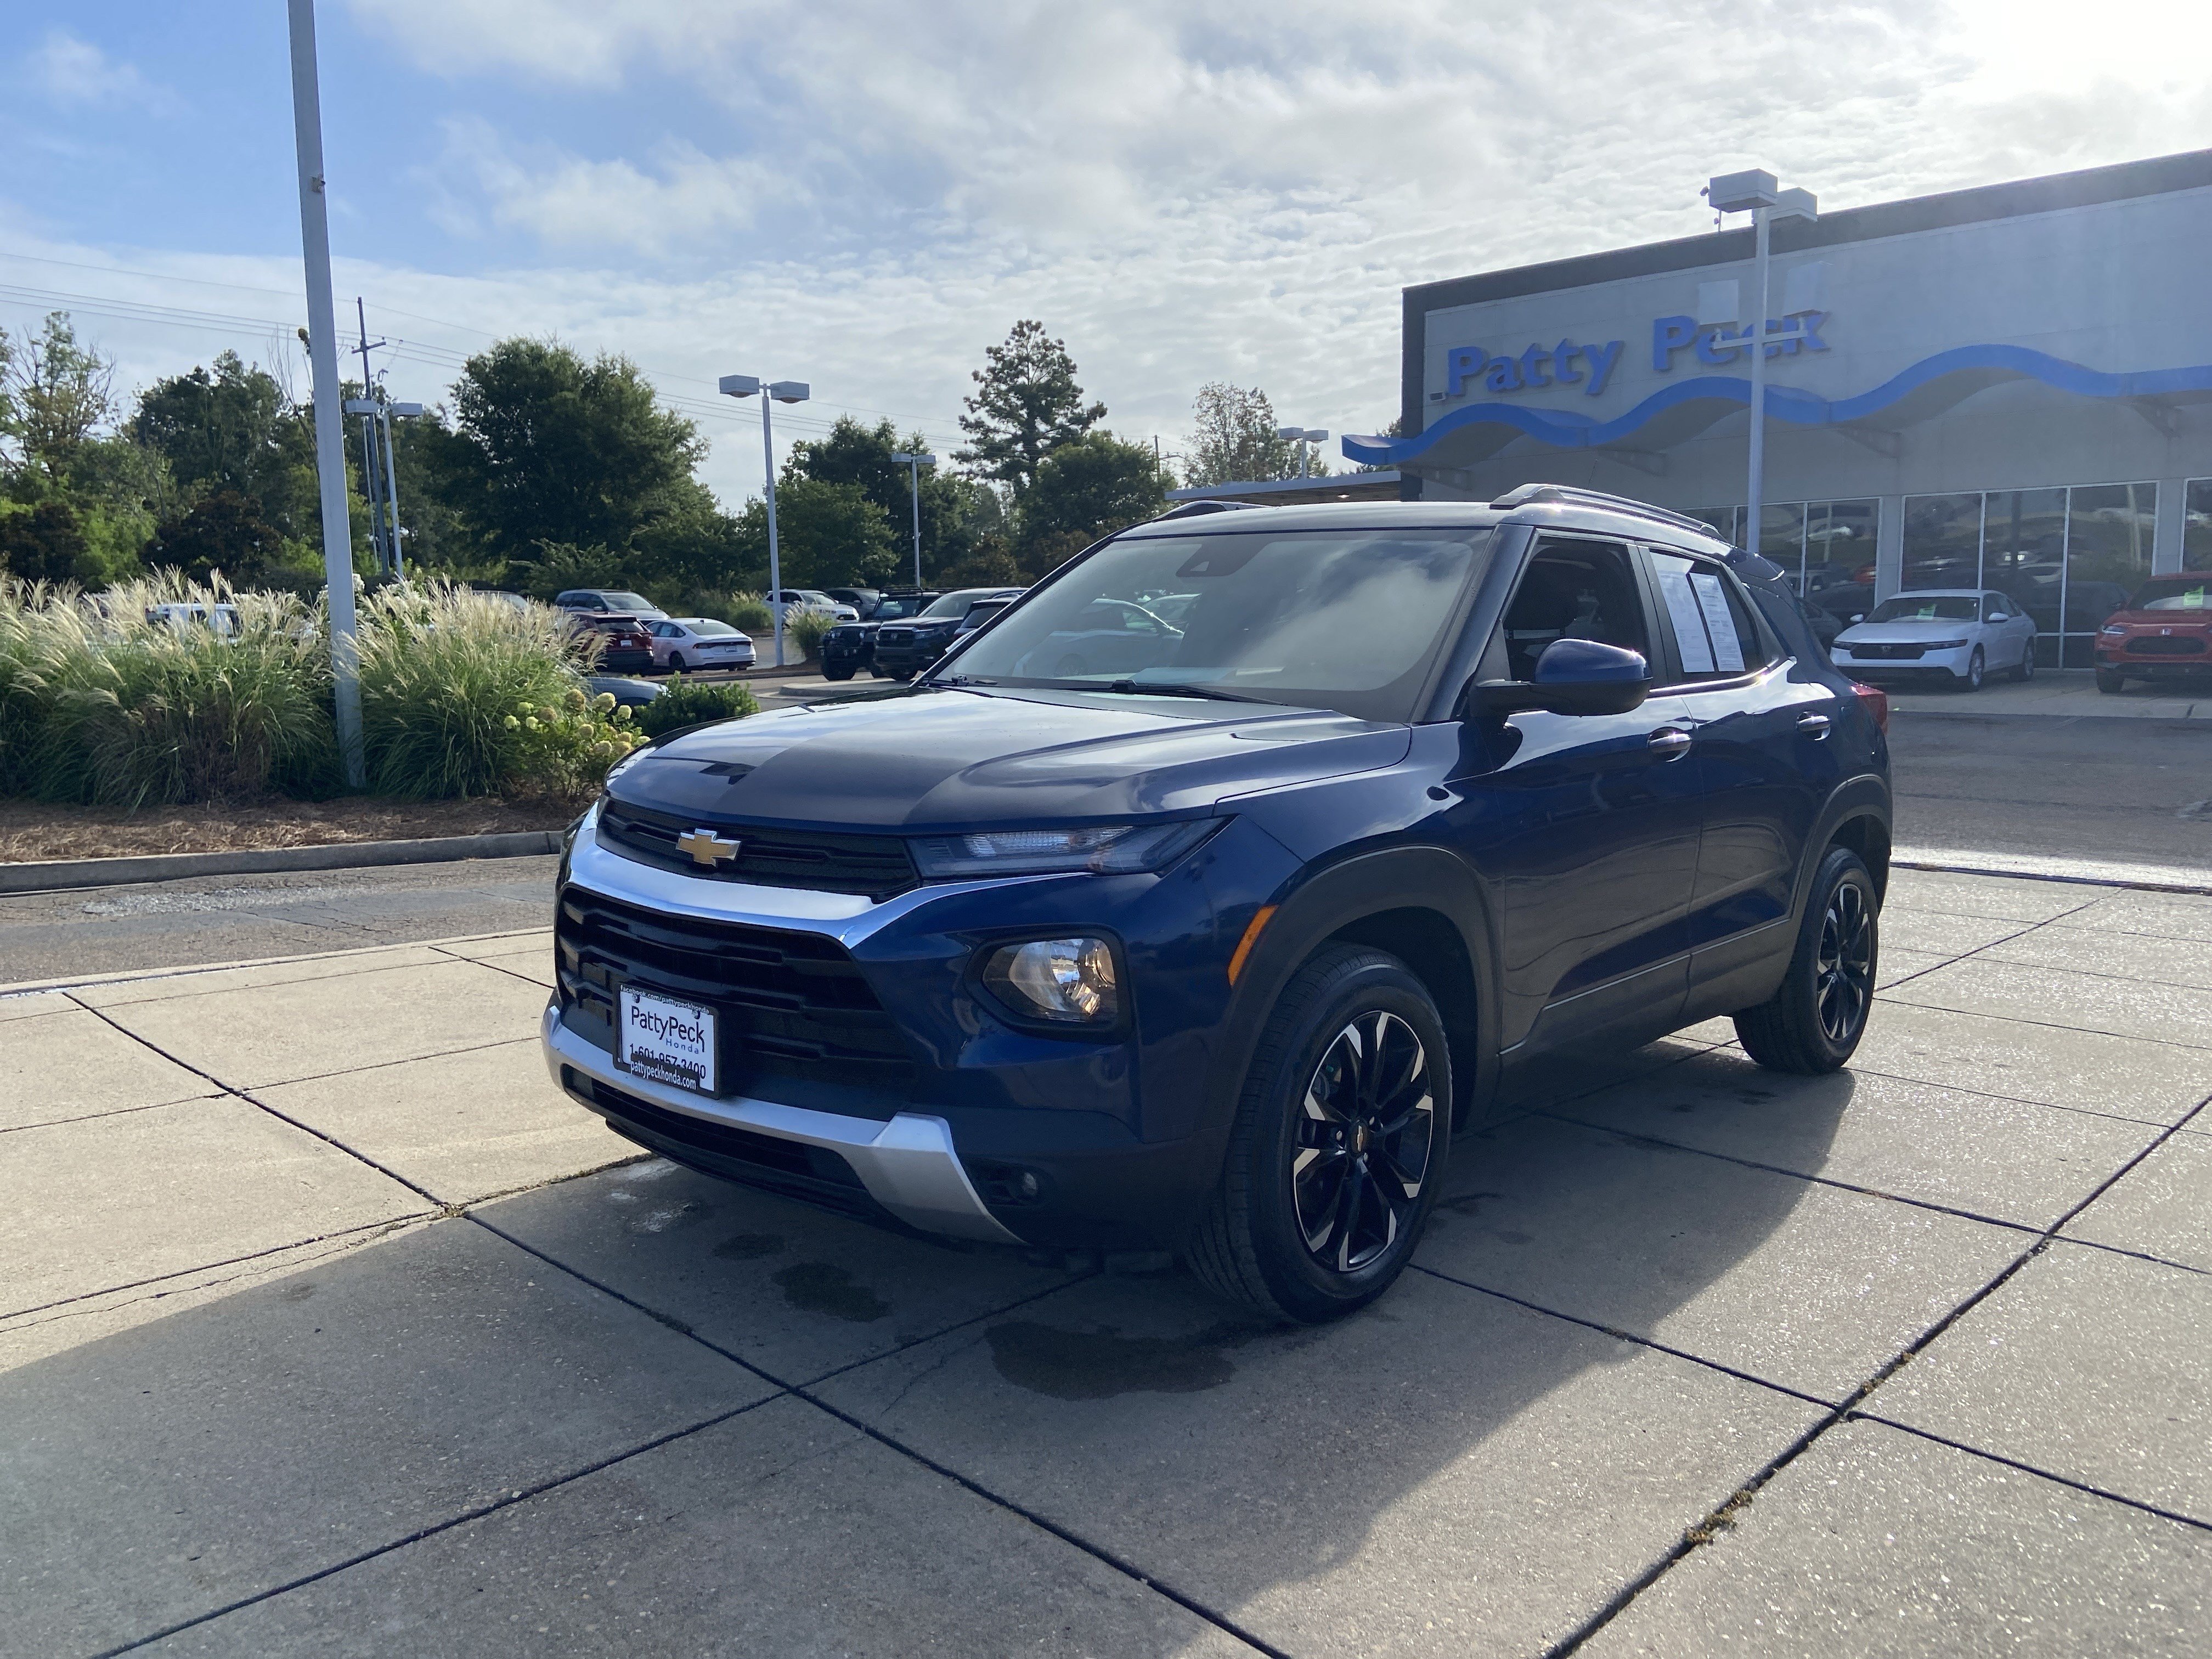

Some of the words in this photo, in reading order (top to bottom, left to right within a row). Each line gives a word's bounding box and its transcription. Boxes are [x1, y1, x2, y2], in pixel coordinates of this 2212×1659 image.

[1448, 337, 1625, 396] Patty
[620, 984, 709, 1014] facebook.com/pattypeckhonda
[631, 1006, 705, 1052] PattyPeck
[666, 1038, 699, 1054] Honda
[630, 1059, 696, 1090] pattypeckhonda.com
